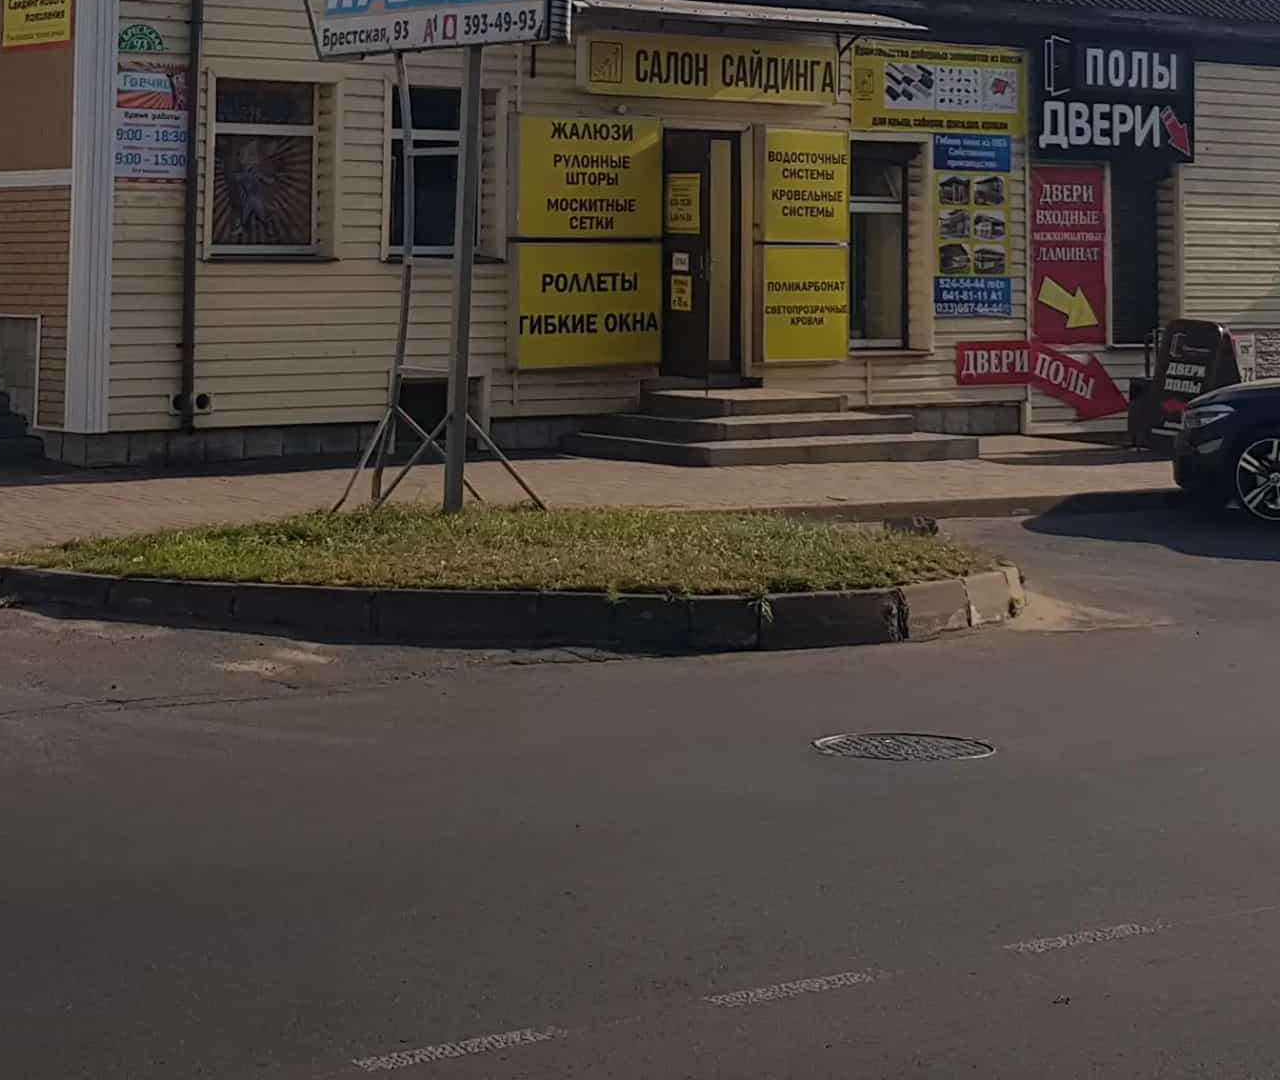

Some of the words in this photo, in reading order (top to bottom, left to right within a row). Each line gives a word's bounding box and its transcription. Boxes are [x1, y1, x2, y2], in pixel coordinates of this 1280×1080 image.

[463, 8, 538, 36] 393-49-93
[322, 26, 391, 48] Брестская,
[393, 20, 410, 40] 93
[635, 49, 709, 87] САЛОН
[721, 49, 835, 95] САЙДИНГА
[1085, 47, 1178, 91] ПОЛЫ
[550, 120, 634, 142] ЖАЛЮЗИ
[1038, 100, 1161, 150] ДВЕРИ
[553, 154, 631, 170] РУЛОННЫЕ
[767, 150, 848, 166] ВОДОСТОЧНЫЕ
[566, 171, 619, 187] ШТОРЫ
[782, 167, 835, 181] СИСТЕМЫ
[771, 189, 843, 203] КРОВЕЛЬНЫЕ
[1040, 184, 1095, 205] ДВЕРИ
[546, 197, 637, 213] МОСКИТНЫЕ
[782, 204, 835, 219] СИСТЕМЫ
[568, 215, 614, 231] СЕТКИ
[1035, 209, 1100, 227] ВХОДНЫЕ
[1036, 246, 1100, 262] ЛАМИНАТ
[541, 271, 639, 294] РОЛЛЕТЫ
[767, 280, 846, 293] ПОЛИКАРБОНАТ
[765, 304, 848, 315] СВЕТОПРОЗРАЧНЫЕ
[519, 312, 597, 337] ГИБКИЕ
[604, 311, 659, 334] ОКНА
[961, 350, 1030, 375] ДВЕРИ
[1034, 351, 1095, 401] ПОЛЫ
[1166, 361, 1207, 378] ДВЕРИ
[1164, 377, 1202, 394] ПОЛЫ
